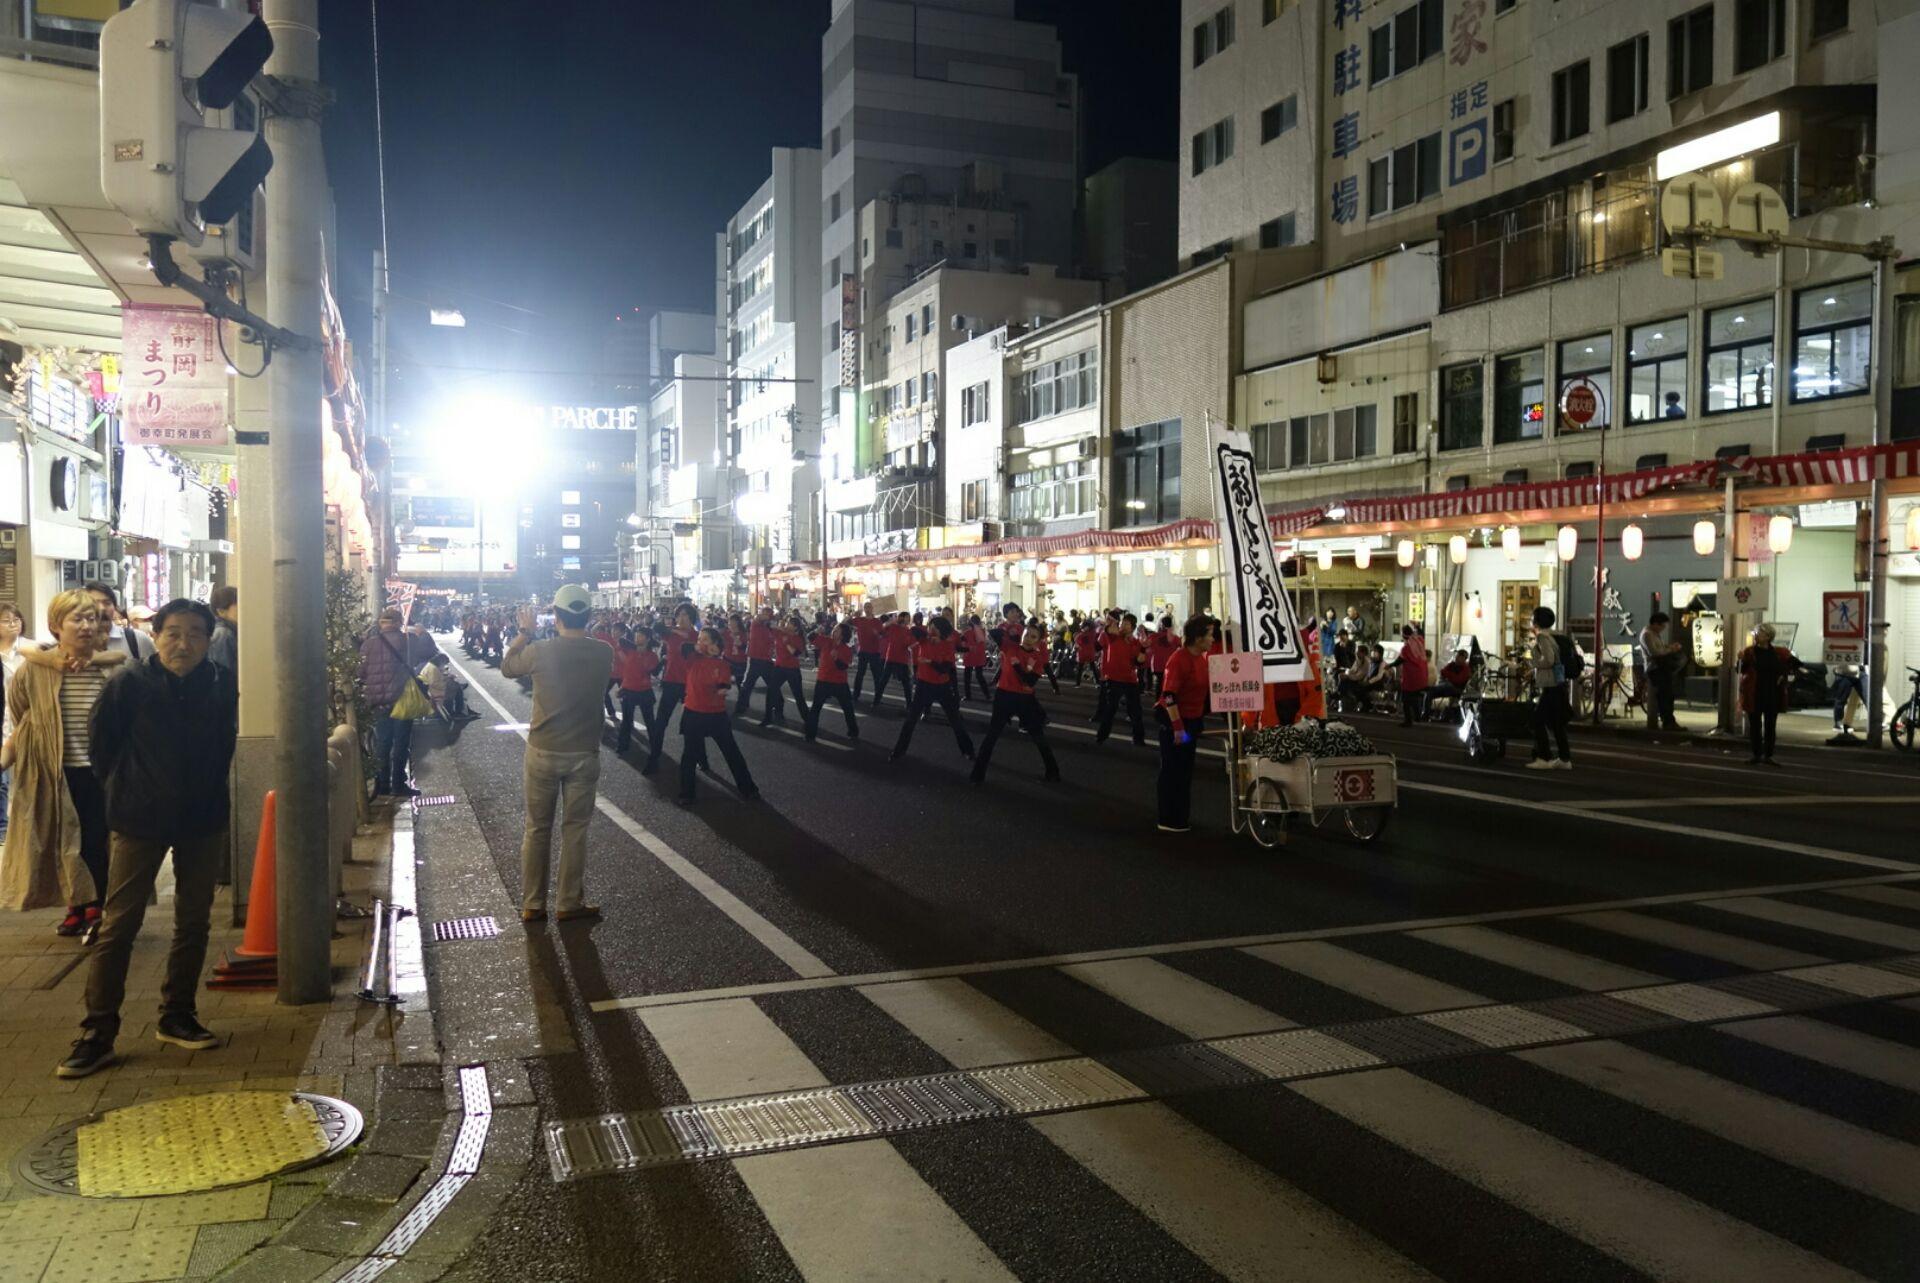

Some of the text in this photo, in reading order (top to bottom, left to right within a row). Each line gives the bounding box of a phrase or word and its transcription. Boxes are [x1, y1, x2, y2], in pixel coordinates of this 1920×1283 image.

[1451, 81, 1488, 120] 指定
[1454, 127, 1483, 179] P
[170, 322, 198, 378] 静岡
[142, 339, 167, 416] まつり
[139, 427, 213, 440] 御幸町発展会
[552, 406, 638, 430] PARCHE
